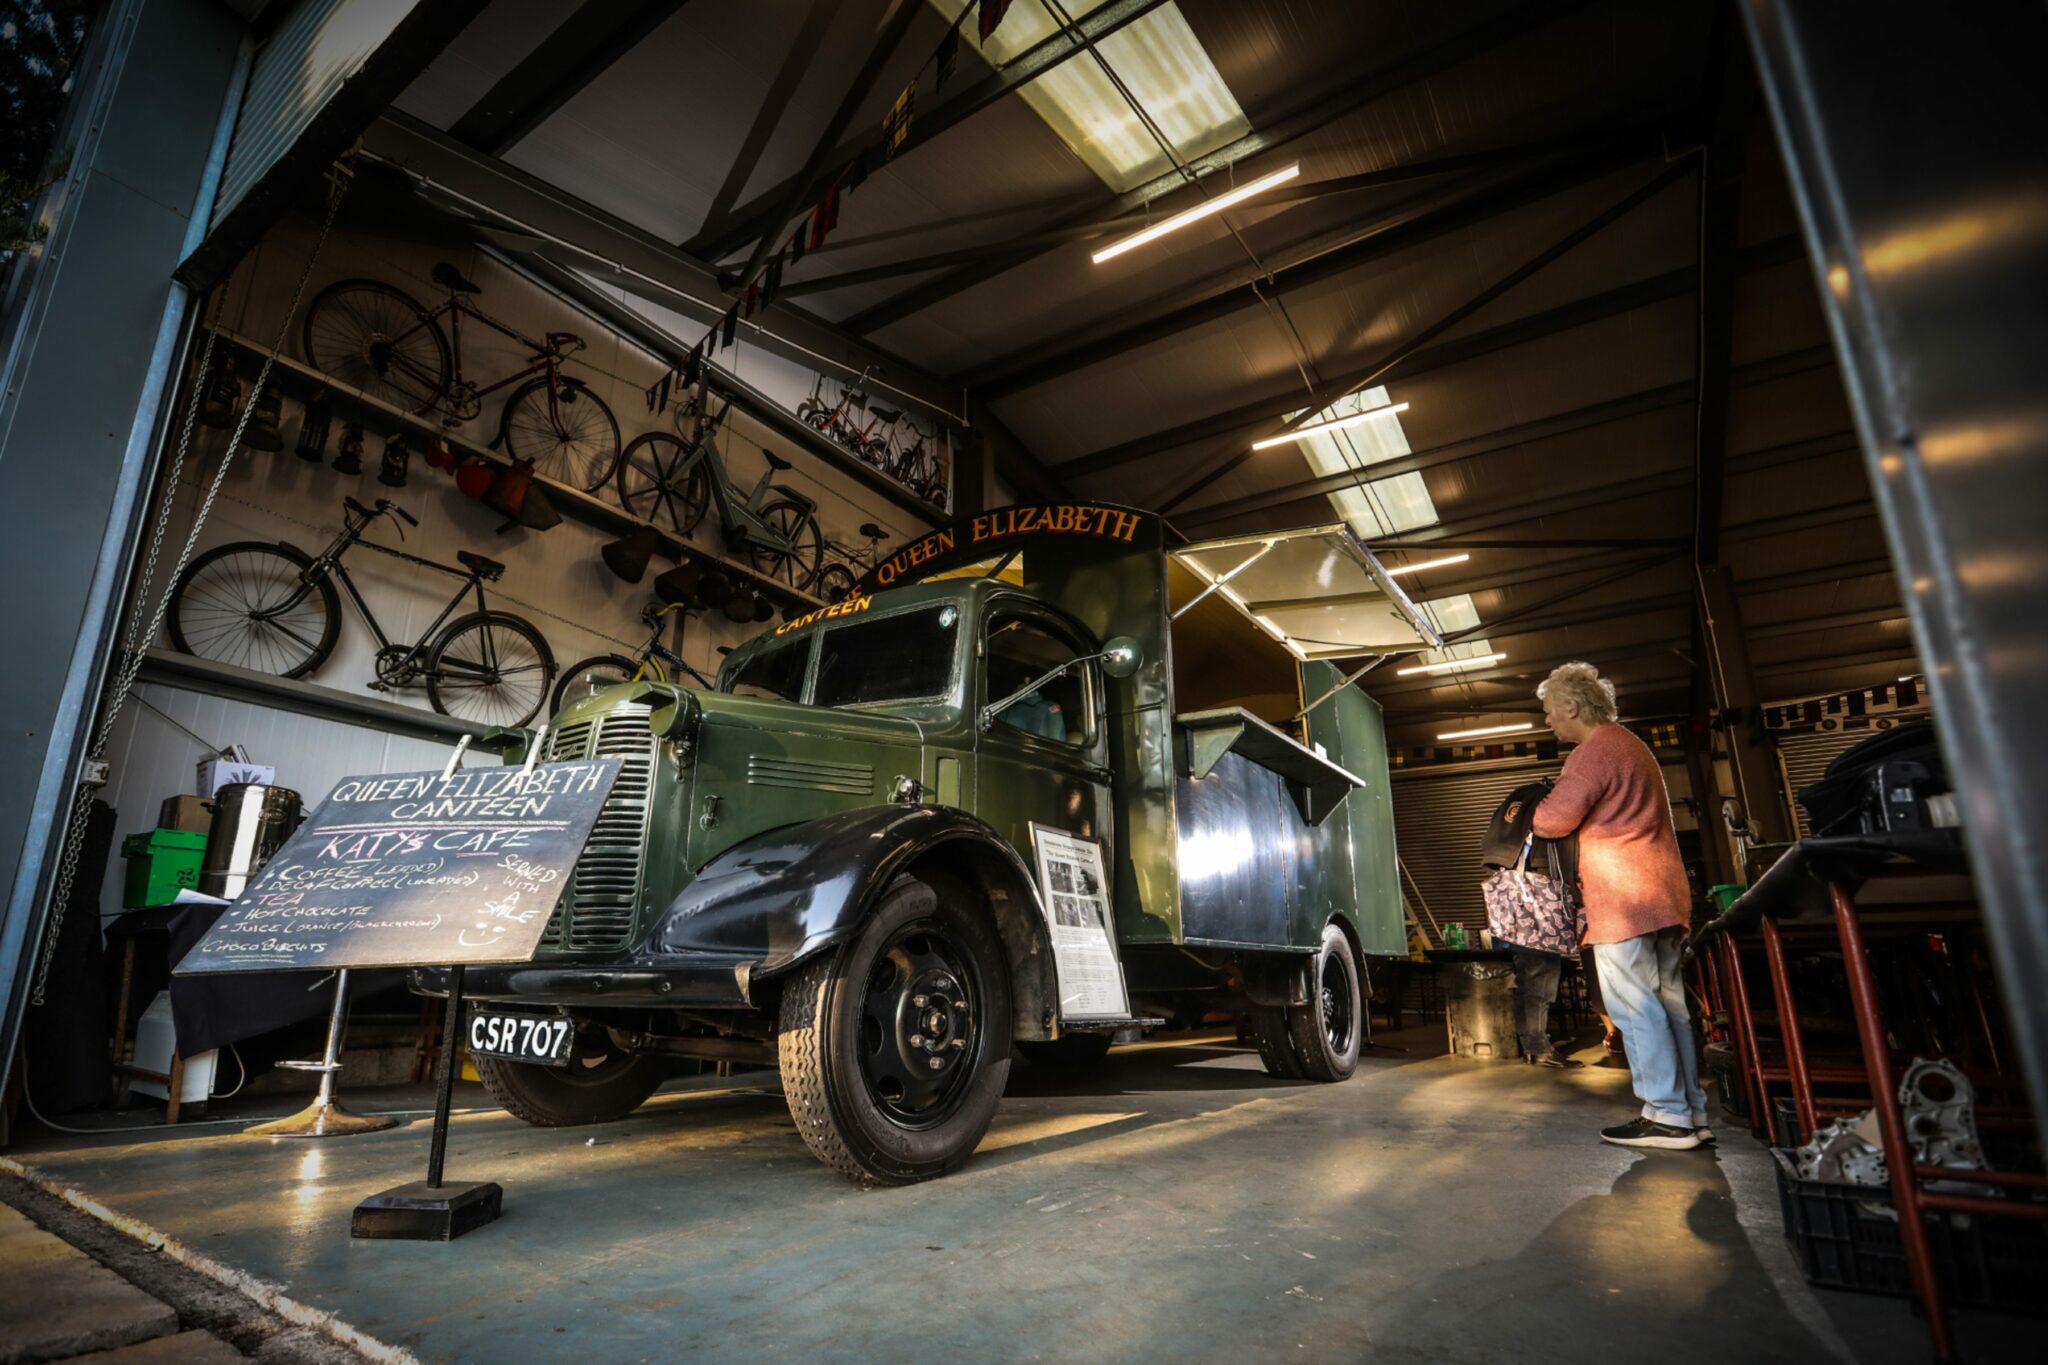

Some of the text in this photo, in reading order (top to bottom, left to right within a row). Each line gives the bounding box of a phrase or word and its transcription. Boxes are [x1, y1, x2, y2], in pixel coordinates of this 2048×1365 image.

[877, 505, 1142, 586] QUEEN ELIZABETH
[775, 594, 873, 637] CANTEEN
[332, 764, 606, 802] QUEEN ELIZABETH
[390, 795, 552, 819] CANTEEN
[433, 829, 531, 852] CAFE
[278, 864, 368, 881] COFFEE
[496, 853, 557, 882] SERVED
[268, 878, 333, 892] DECAF
[503, 875, 540, 893] WITH
[258, 892, 305, 906] TEA
[502, 891, 520, 904] A
[245, 905, 373, 920] HOT CHOCOLATE
[230, 922, 282, 933] JUICE
